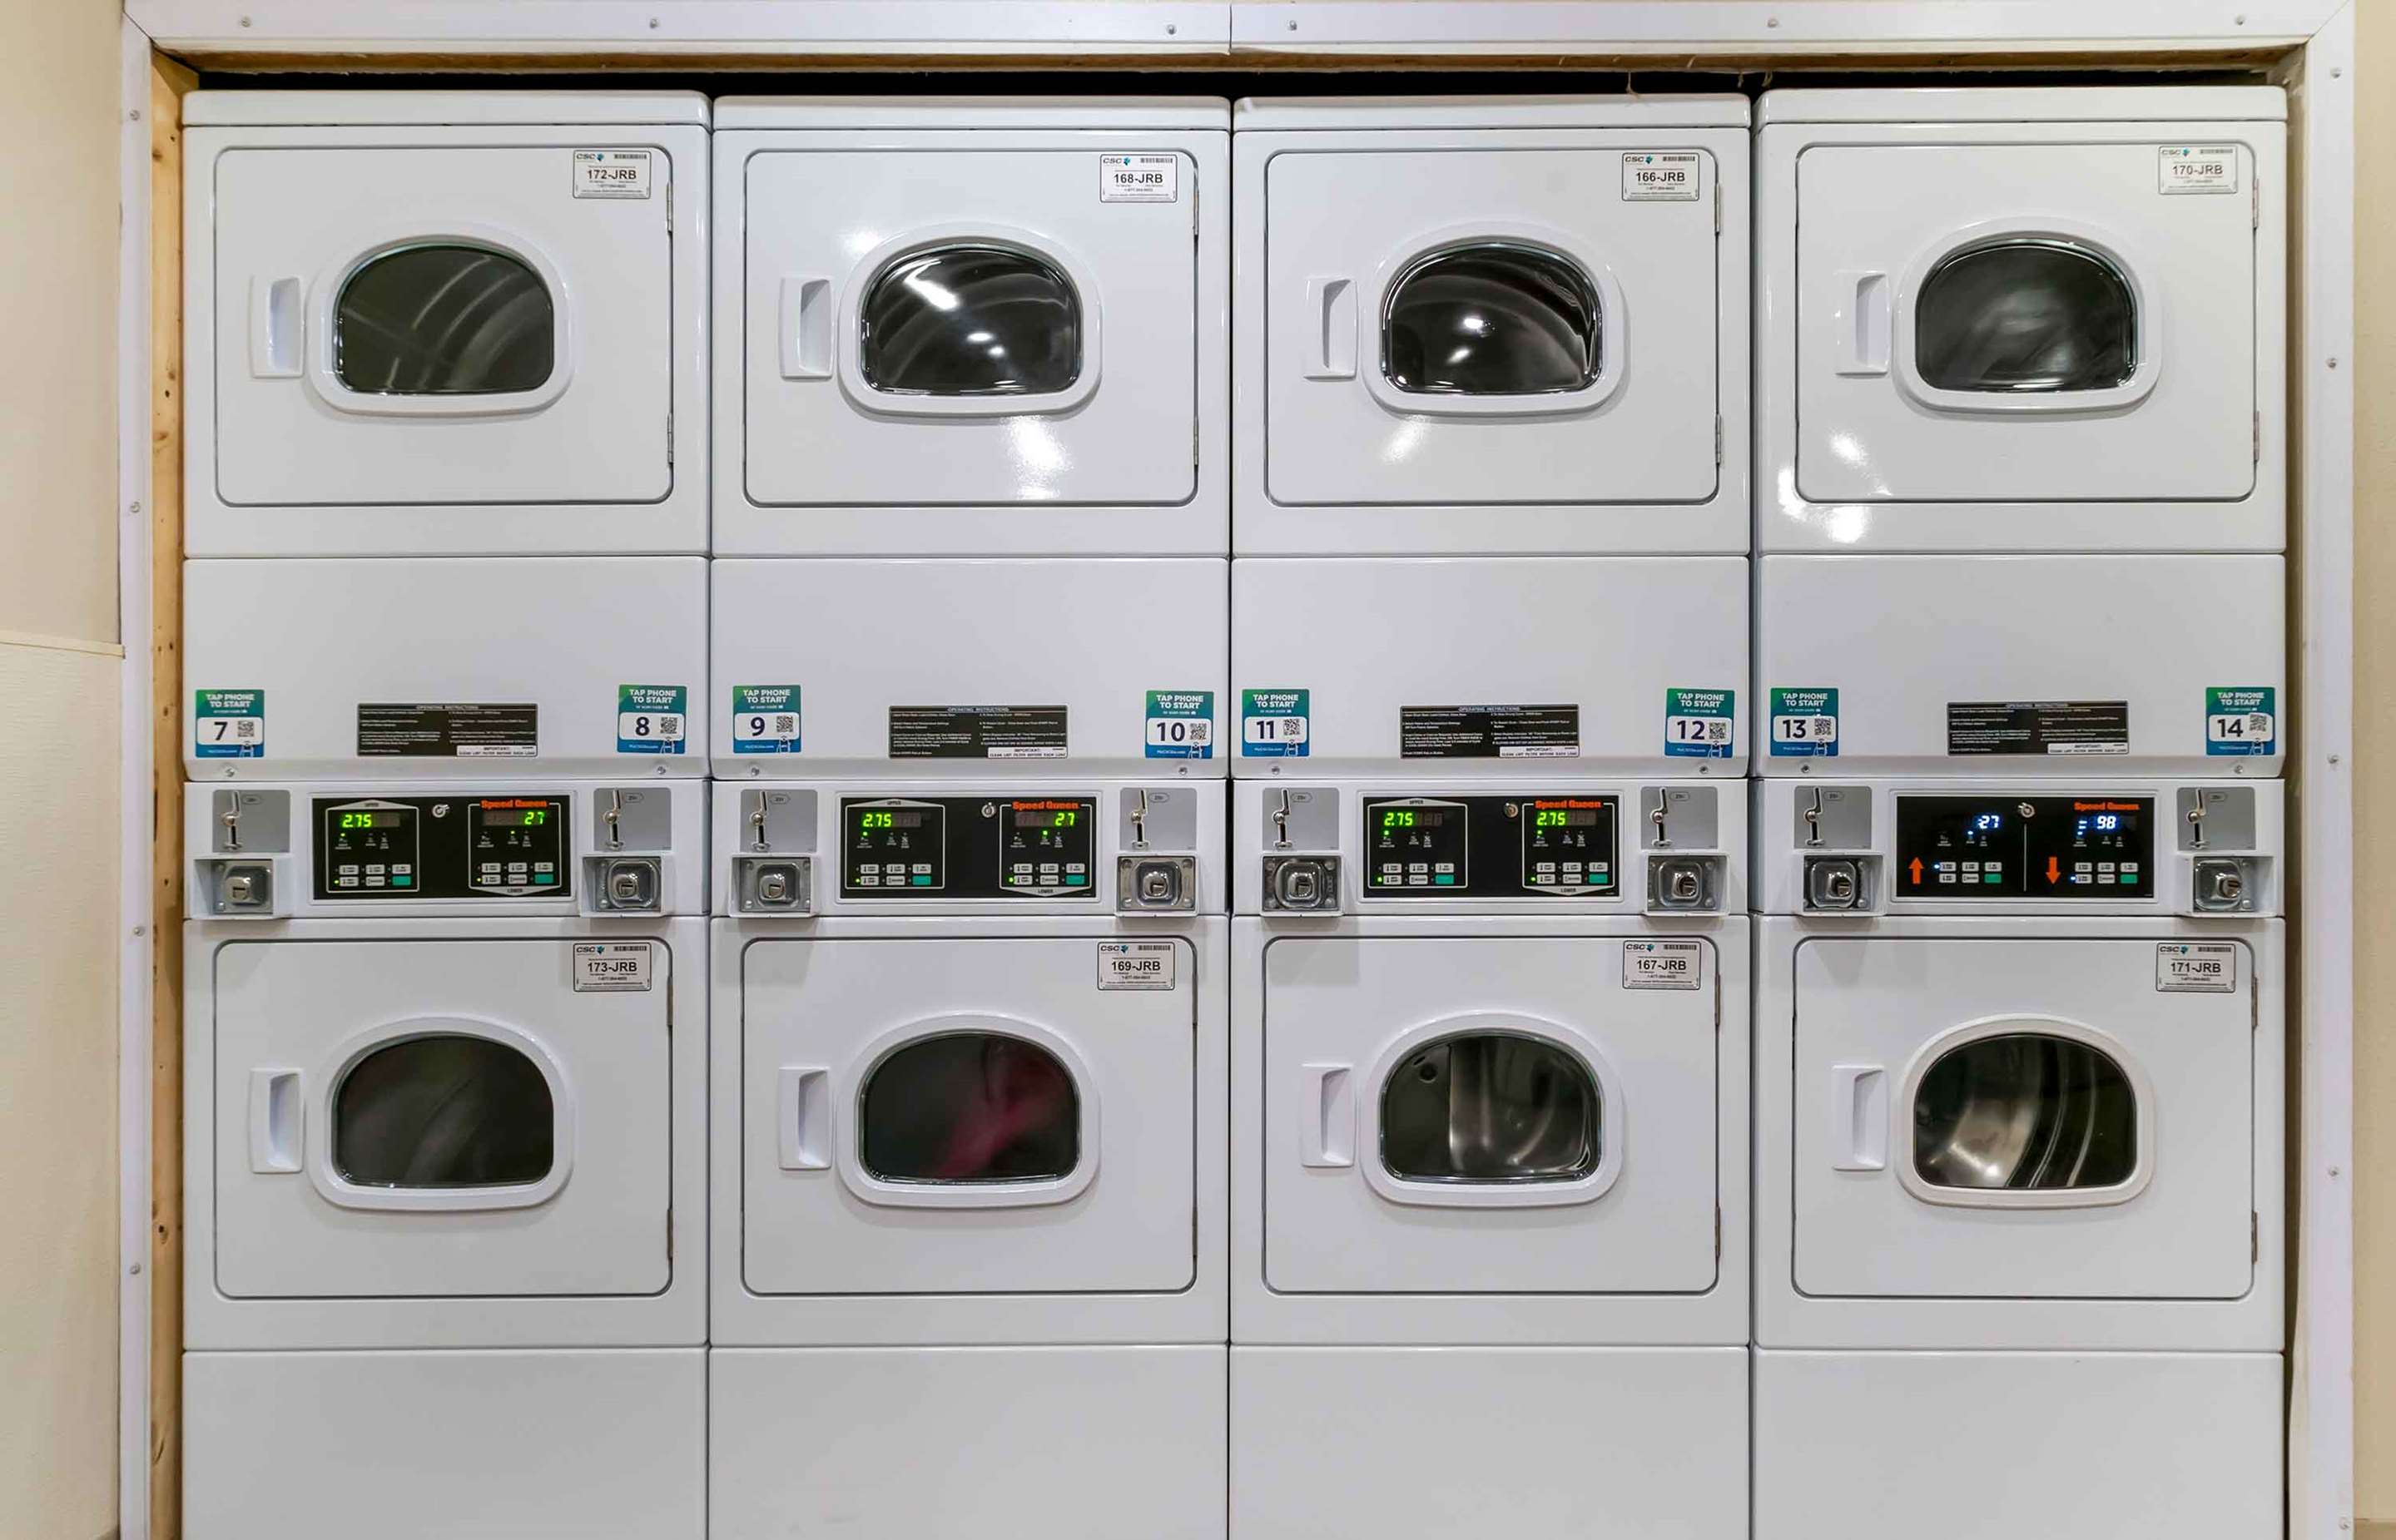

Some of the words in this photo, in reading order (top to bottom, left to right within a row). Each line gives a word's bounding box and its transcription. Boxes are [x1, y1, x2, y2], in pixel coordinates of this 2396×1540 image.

[588, 170, 637, 180] 172-JRB
[1636, 172, 1685, 182] 166-JRB
[2173, 165, 2223, 176] 170-JRB
[1114, 174, 1163, 184] 168-JRB
[214, 721, 228, 740] 7
[635, 716, 650, 736] 8
[750, 716, 765, 736] 9
[1157, 722, 1185, 741] 10
[1256, 720, 1274, 739] 11
[1677, 720, 1705, 740] 12
[1783, 719, 1806, 738] 13
[2217, 719, 2244, 738] 14
[481, 800, 513, 809] Speed
[515, 799, 547, 808] Queen
[1012, 801, 1044, 810] Speed
[1046, 801, 1079, 810] Queen
[1535, 800, 1567, 809] Speed
[1569, 800, 1602, 808] Queen
[2074, 802, 2106, 810] Speed
[342, 815, 372, 827] 2.75
[524, 811, 545, 825] 27
[863, 814, 891, 827] 2.75
[1054, 812, 1075, 826] 27
[1384, 812, 1413, 825] 2.75
[1537, 812, 1565, 825] 2.75
[2097, 815, 2116, 829] 98
[588, 962, 637, 973] 173-JRB
[1111, 961, 1160, 971] 169-JRB
[1636, 960, 1686, 970] 167-JRB
[2170, 963, 2220, 973] 171-JRB
